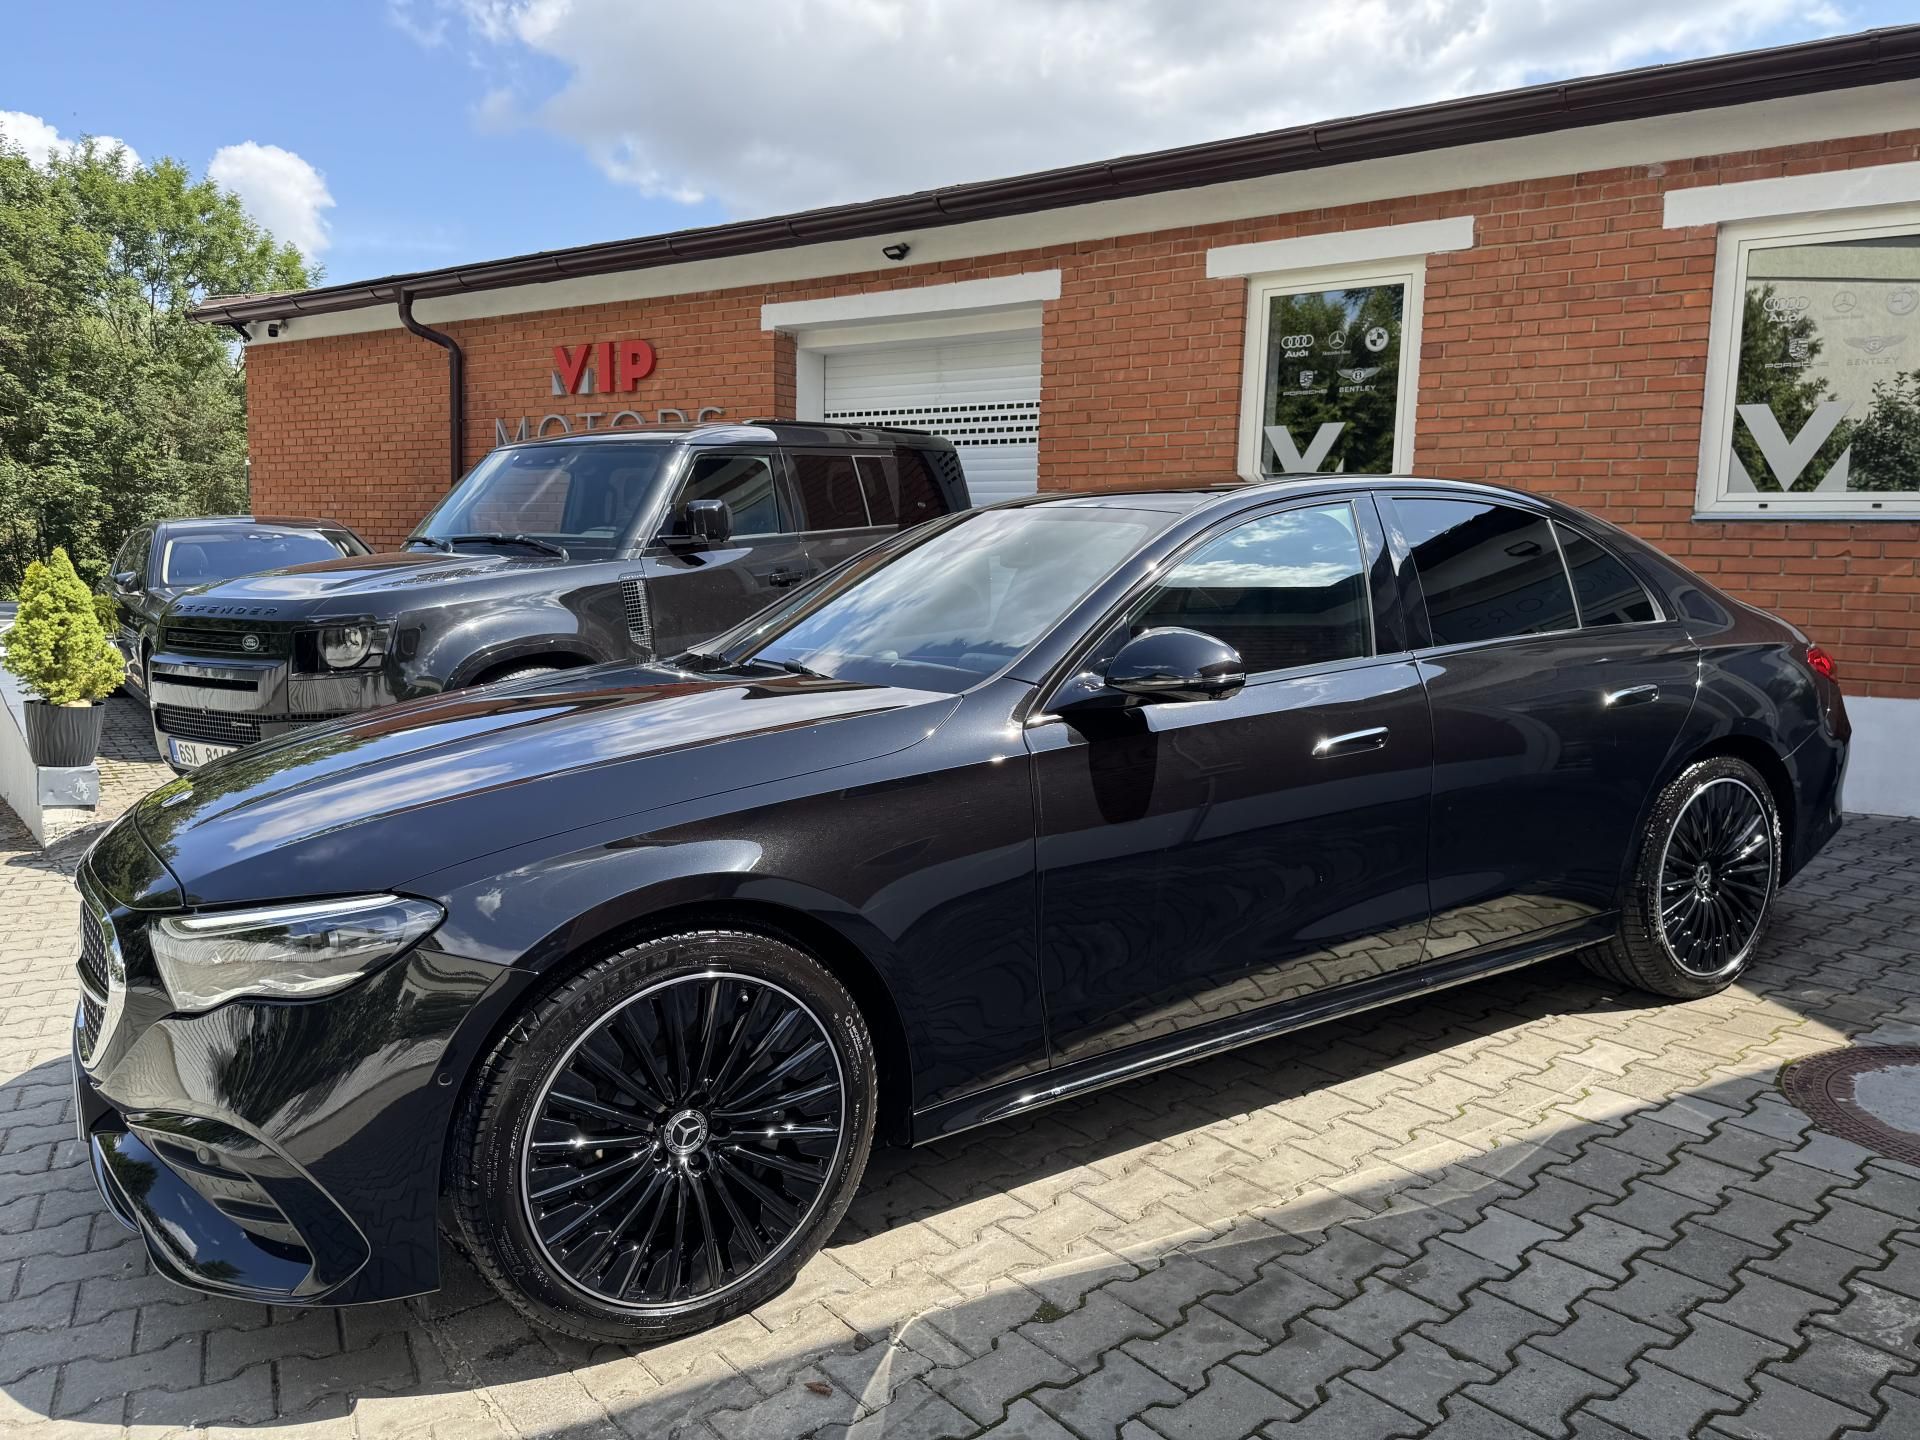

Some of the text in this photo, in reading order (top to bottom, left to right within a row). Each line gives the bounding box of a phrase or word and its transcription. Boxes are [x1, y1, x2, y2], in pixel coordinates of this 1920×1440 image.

[1768, 313, 1802, 323] Aud
[1284, 349, 1309, 358] Audi
[553, 339, 657, 395] VIP
[1339, 385, 1376, 393] BENTLEY
[175, 603, 279, 615] DEFENDER
[178, 743, 200, 765] 6SX
